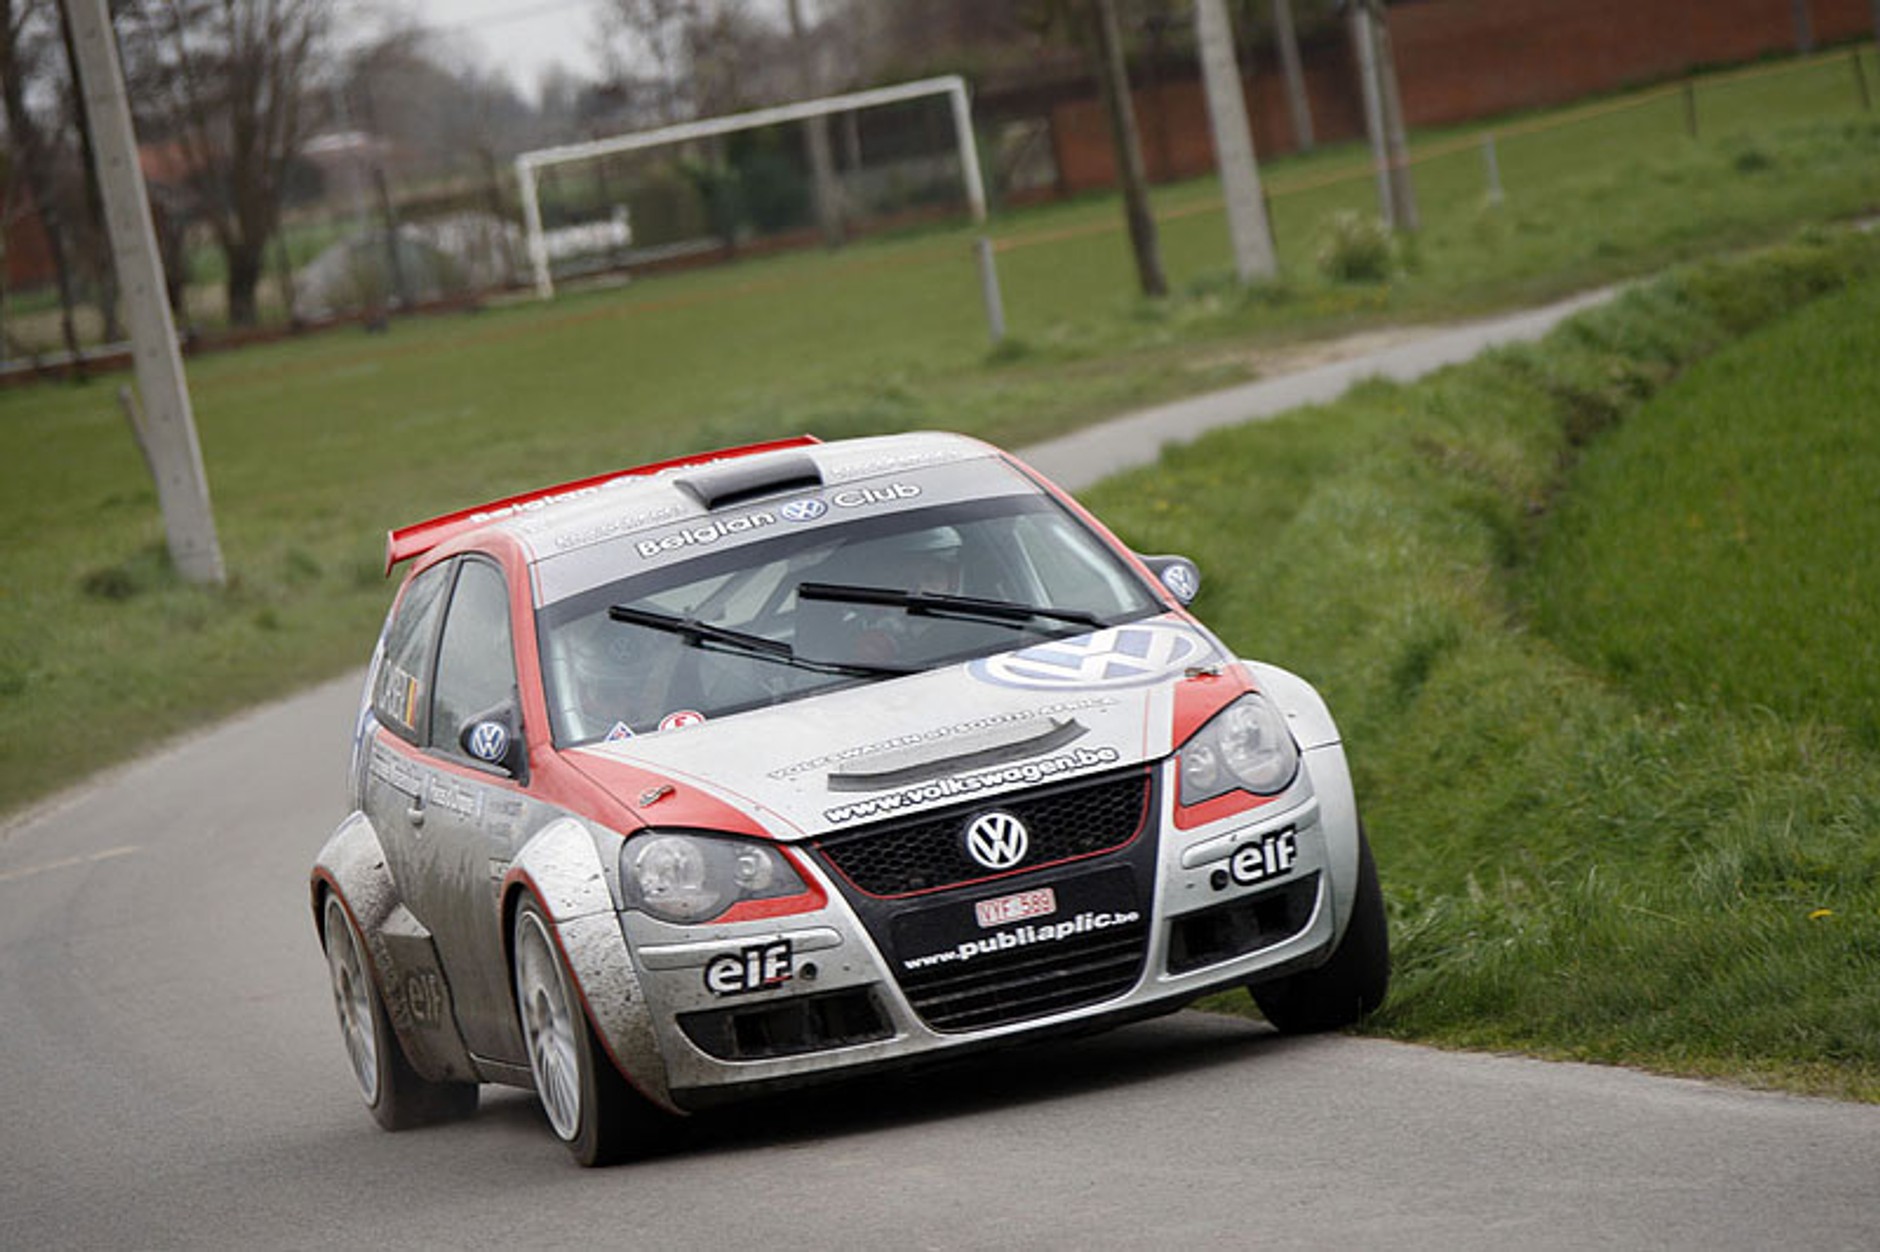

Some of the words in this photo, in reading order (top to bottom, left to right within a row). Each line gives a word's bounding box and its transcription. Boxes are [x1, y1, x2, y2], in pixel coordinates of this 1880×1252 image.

[636, 511, 776, 559] Belgian
[833, 480, 923, 509] Club
[824, 744, 1120, 825] www.volkswagen.be
[904, 911, 1140, 971] www.publiaplic.be
